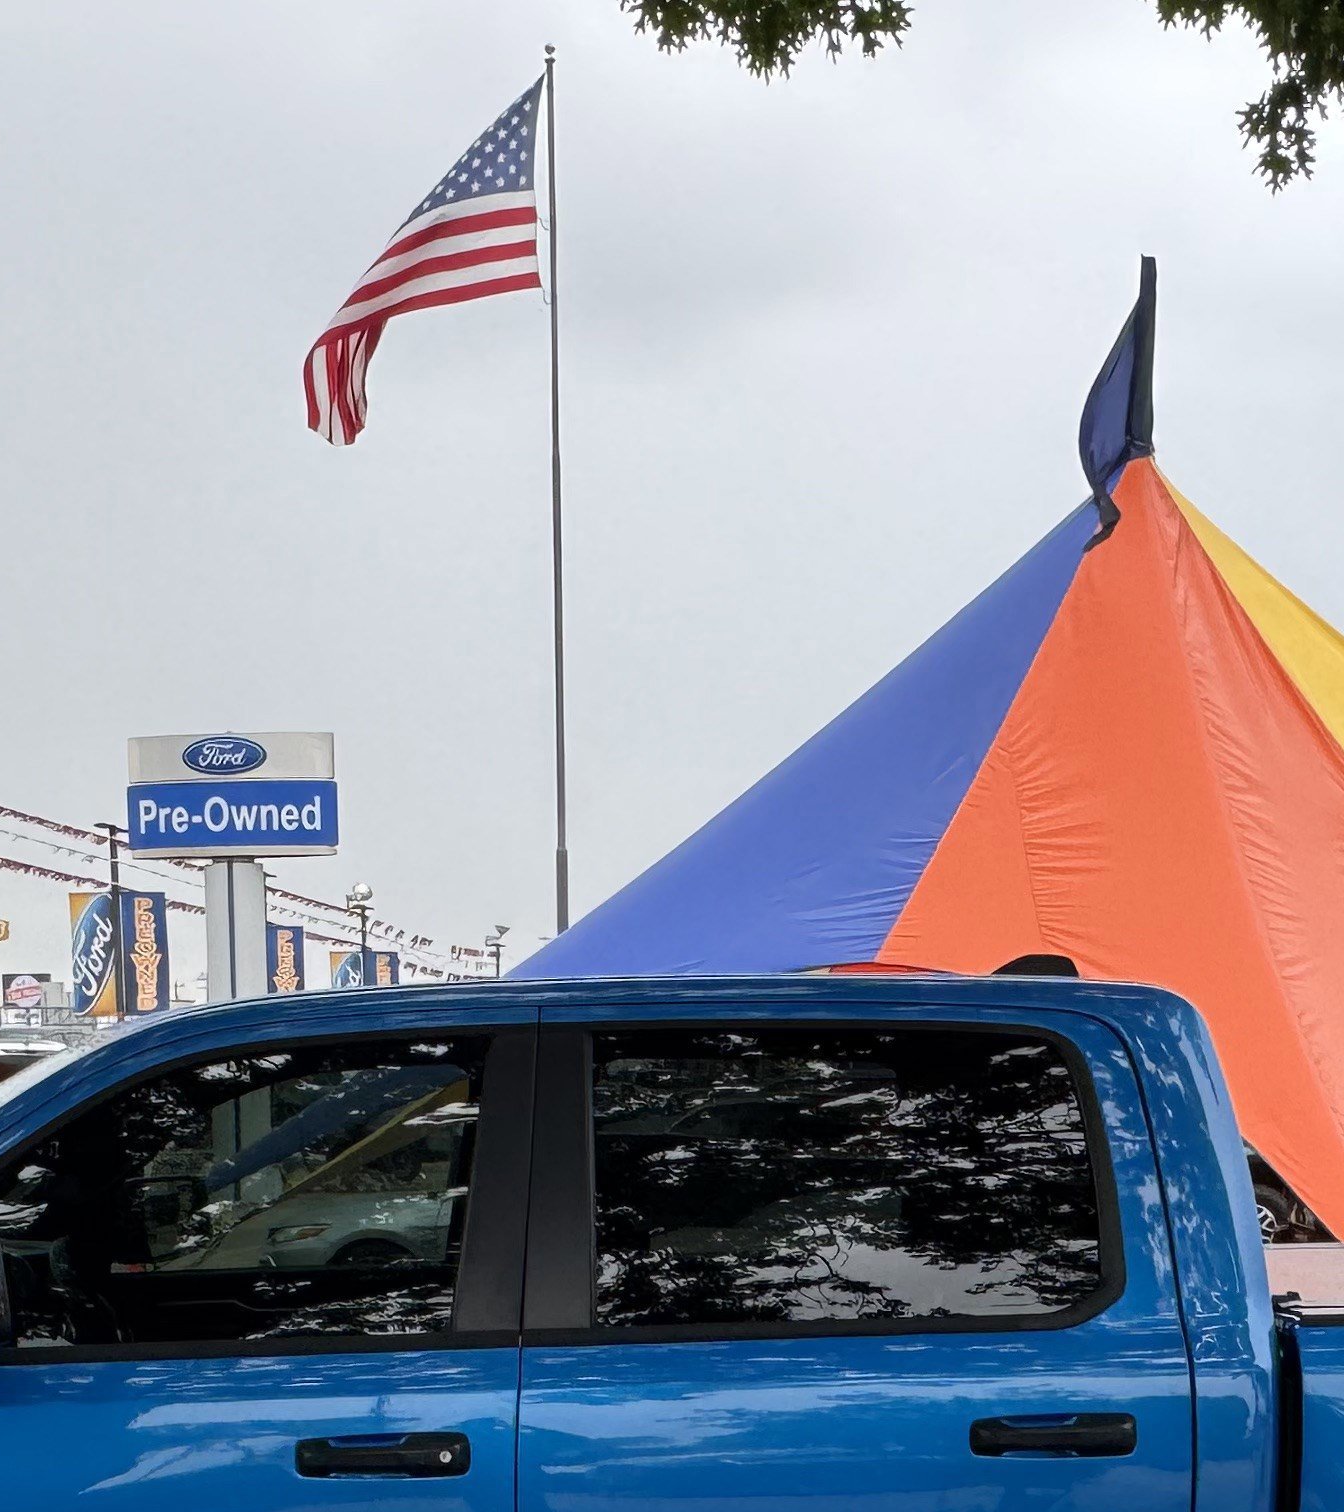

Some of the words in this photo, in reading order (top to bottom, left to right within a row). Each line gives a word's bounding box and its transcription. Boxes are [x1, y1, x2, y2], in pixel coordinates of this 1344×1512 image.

[198, 742, 247, 768] Ford
[138, 796, 322, 834] Pre-Owned
[74, 912, 112, 996] Ford
